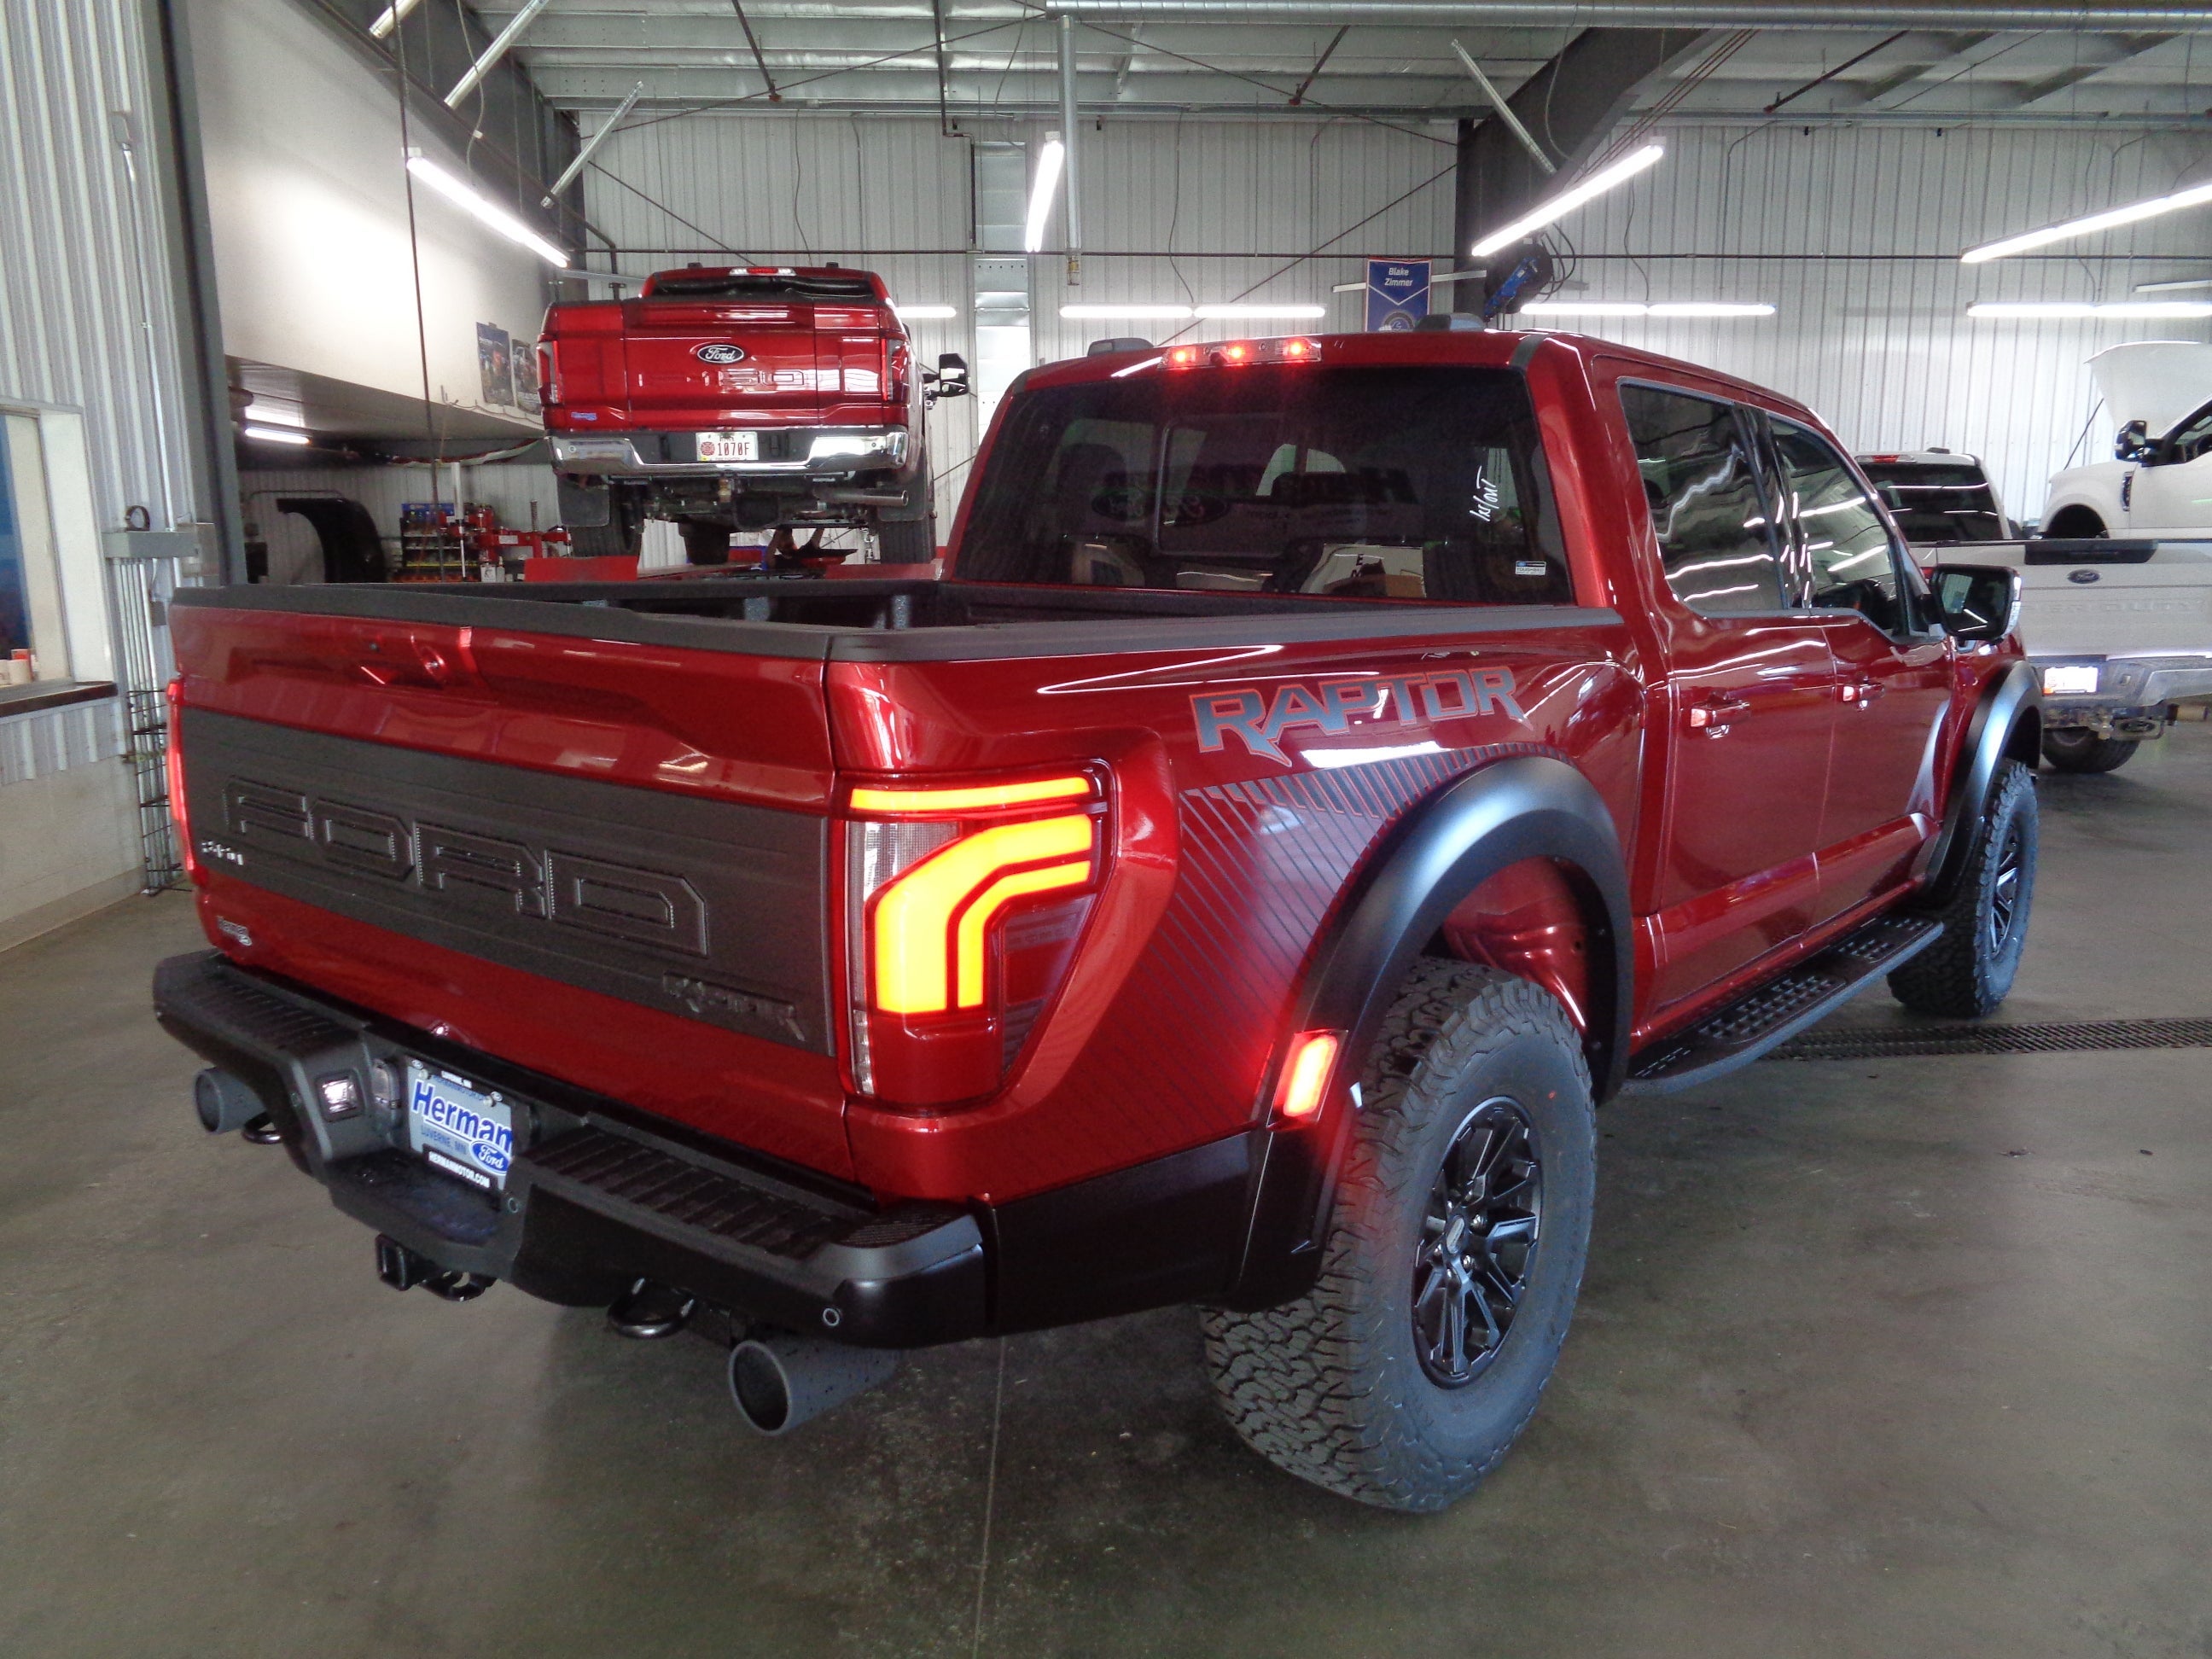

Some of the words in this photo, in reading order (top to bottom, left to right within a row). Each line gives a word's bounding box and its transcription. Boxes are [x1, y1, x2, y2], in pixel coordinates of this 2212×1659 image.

[1384, 277, 1413, 287] Zimmer
[1388, 267, 1410, 276] Blake
[704, 346, 736, 362] Ford
[718, 442, 750, 456] 1070F
[1189, 665, 1534, 767] RAPTOR
[221, 775, 710, 957] FORD
[411, 1079, 512, 1154] Herman
[478, 1144, 505, 1169] Ford
[428, 1151, 491, 1189] HERMANMOTOR.COM
